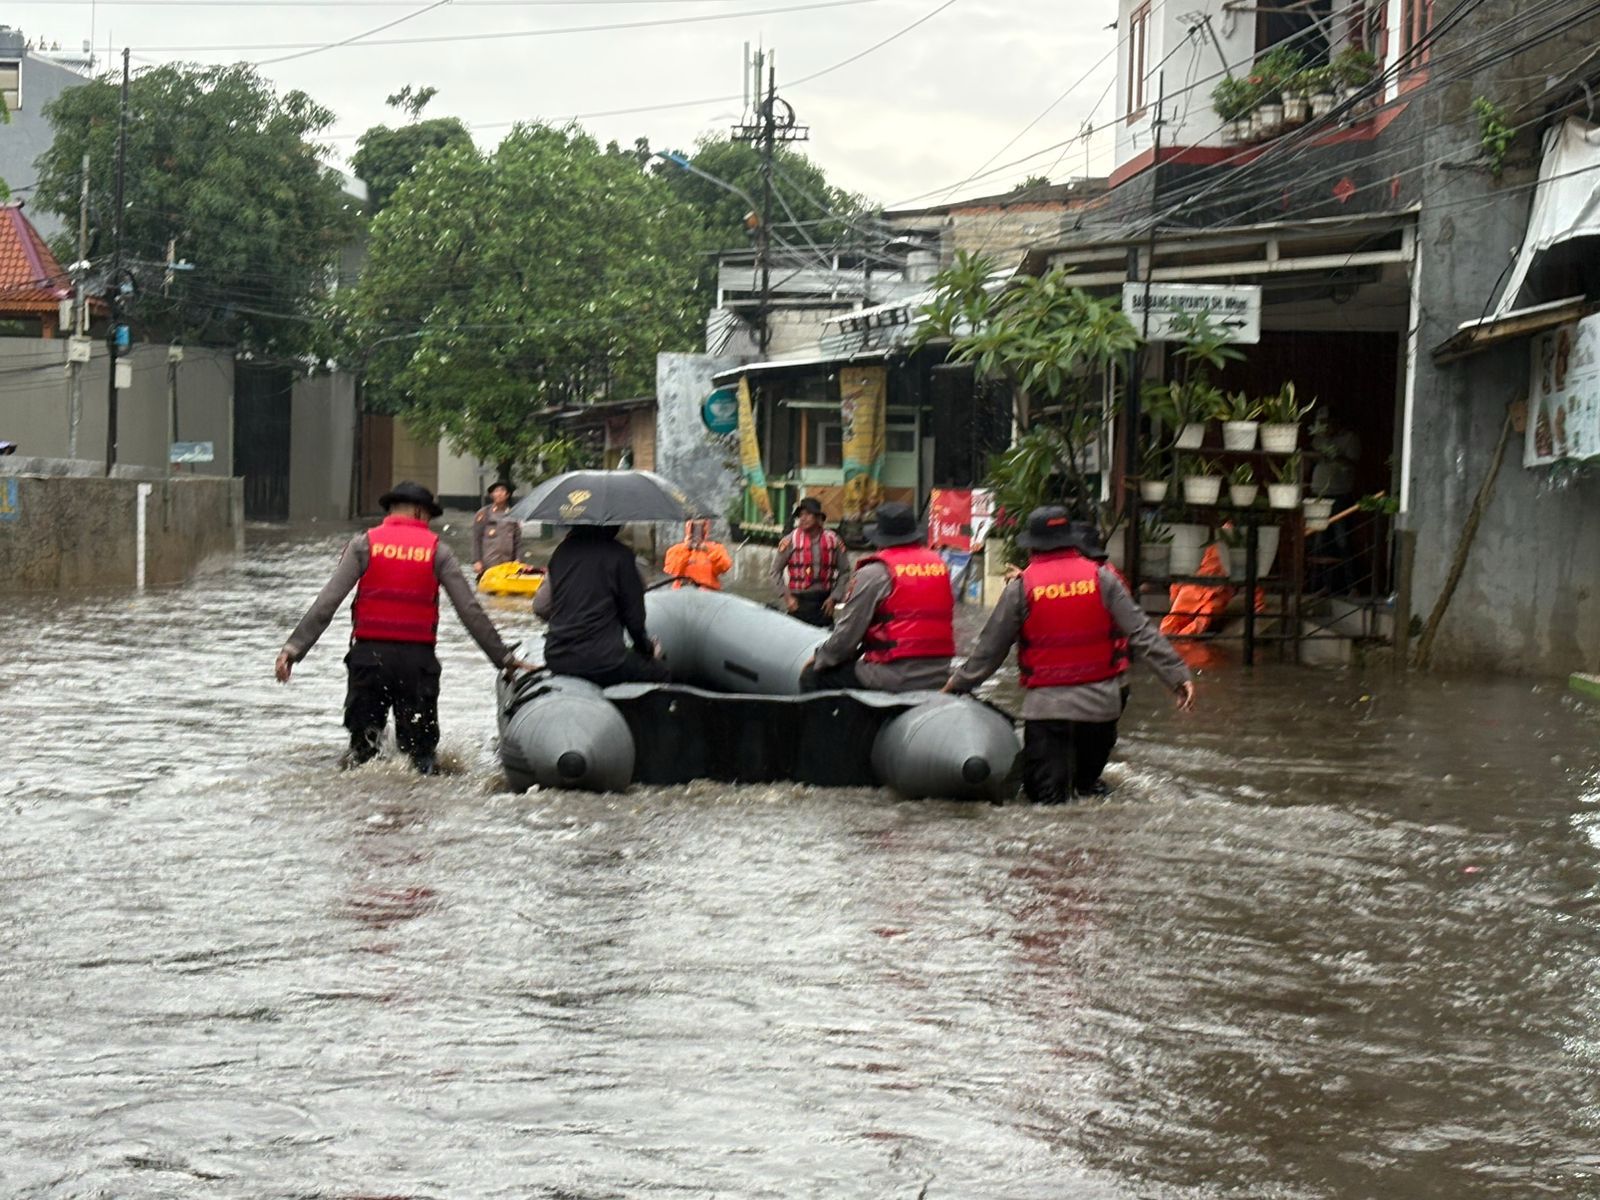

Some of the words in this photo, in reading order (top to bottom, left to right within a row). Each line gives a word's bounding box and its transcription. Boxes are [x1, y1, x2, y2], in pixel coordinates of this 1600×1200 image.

[371, 543, 432, 562] POLISI
[895, 562, 946, 577] POLISI
[1033, 579, 1096, 602] POLISI
